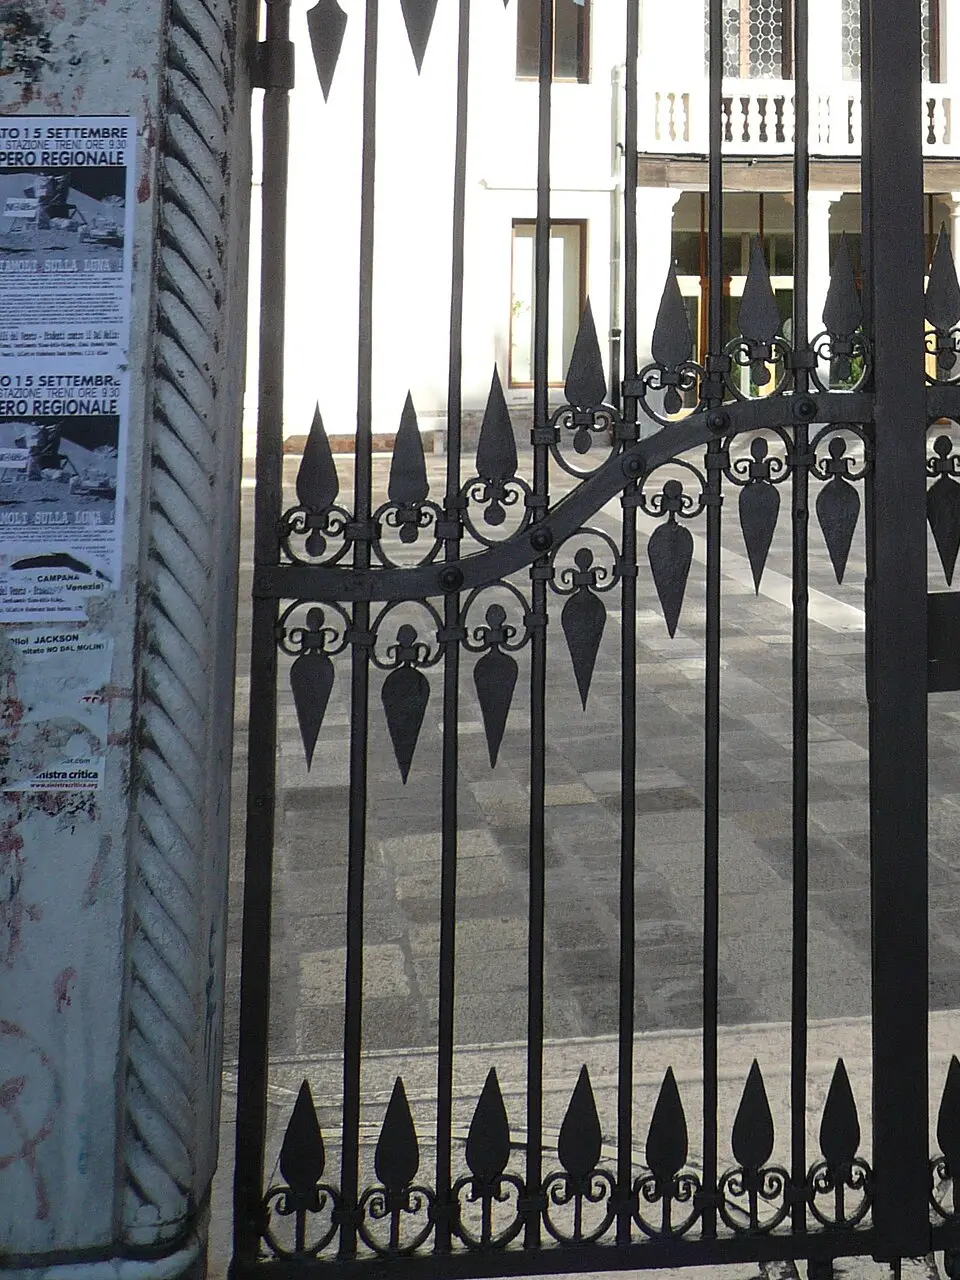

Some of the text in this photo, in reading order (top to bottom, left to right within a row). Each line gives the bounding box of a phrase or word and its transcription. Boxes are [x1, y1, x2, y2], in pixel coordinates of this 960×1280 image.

[0, 128, 20, 139] TO
[47, 127, 128, 139] SETTEMBRE
[6, 140, 50, 150] STAZIONE
[55, 140, 81, 150] TRENI
[86, 140, 104, 150] ORE
[42, 151, 124, 166] REGIONALE
[46, 388, 74, 398] TRENI
[79, 388, 97, 398] ORE
[33, 399, 117, 415] REGIONALE
[34, 634, 79, 644] JACKSON
[69, 769, 98, 779] critica
